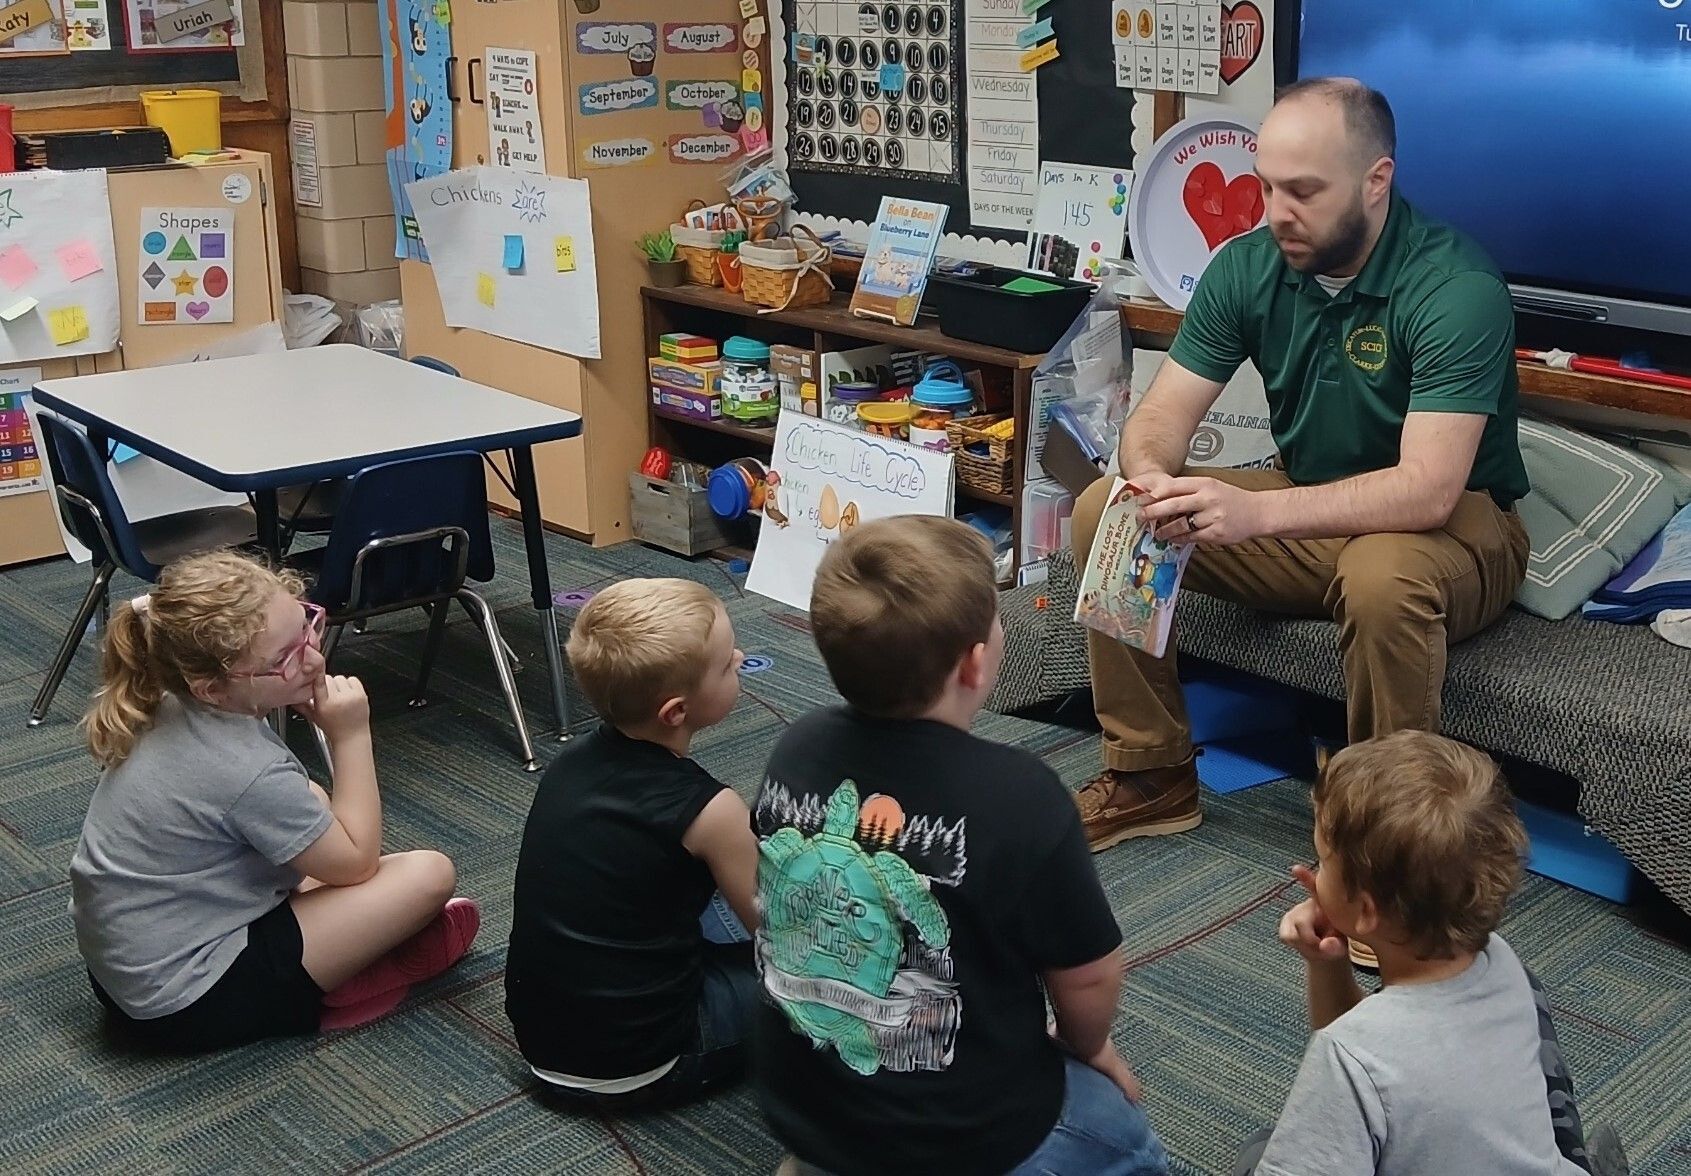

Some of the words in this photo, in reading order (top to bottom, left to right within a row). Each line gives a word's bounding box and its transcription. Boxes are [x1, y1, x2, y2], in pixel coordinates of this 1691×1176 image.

[983, 0, 1020, 16] Sunday
[173, 11, 213, 33] Uriah
[889, 10, 896, 28] 2
[910, 11, 918, 30] 3
[931, 11, 939, 30] 4
[602, 31, 629, 47] July
[680, 30, 721, 46] August
[1162, 33, 1174, 41] Left
[1204, 35, 1216, 43] Left
[1221, 22, 1256, 56] ART
[842, 43, 850, 61] 7
[865, 46, 873, 64] 8
[889, 43, 896, 62] 9
[910, 49, 920, 67] 10
[932, 48, 942, 66] 11
[681, 85, 726, 99] October
[801, 73, 811, 92] 12
[843, 74, 854, 94] 14
[911, 81, 922, 98] 17
[934, 81, 944, 100] 18
[972, 77, 1031, 97] Wednesday
[589, 86, 649, 106] September
[800, 105, 809, 122] 19
[819, 105, 831, 124] 20
[843, 104, 854, 121] 21
[889, 110, 899, 129] 23
[910, 111, 921, 131] 24
[932, 115, 946, 136] 25
[980, 121, 1026, 143] Thursday
[592, 144, 648, 159] November
[680, 141, 731, 154] December
[799, 137, 810, 156] 26
[822, 139, 834, 157] 27
[844, 141, 857, 159] 28
[866, 143, 878, 163] 29
[888, 143, 901, 162] 30
[1173, 144, 1198, 166] We
[1199, 131, 1236, 149] Wish
[1241, 133, 1258, 154] Yo
[523, 153, 538, 163] HELP
[987, 147, 1018, 168] Friday
[980, 170, 1026, 193] Saturday
[1089, 173, 1099, 187] K
[430, 184, 503, 207] Chickens
[522, 194, 539, 211] are
[887, 203, 910, 217] Bella
[911, 207, 936, 220] Bean
[974, 202, 990, 213] DAYS
[991, 203, 1000, 214] OF
[1001, 204, 1016, 215] THE
[1015, 205, 1034, 216] WEEK
[1063, 199, 1094, 227] 145
[160, 212, 219, 234] Shapes
[880, 222, 913, 238] Blueberry
[913, 229, 930, 239] Lane
[1, 448, 12, 457] 15
[791, 431, 838, 467] Chicken
[849, 447, 873, 479] Life
[884, 458, 920, 493] Cycle
[2, 465, 14, 475] 19
[1096, 547, 1110, 572] THE
[1103, 522, 1116, 551] LOST
[1100, 540, 1120, 593] DINOSAUR
[1116, 511, 1131, 540] BONE
